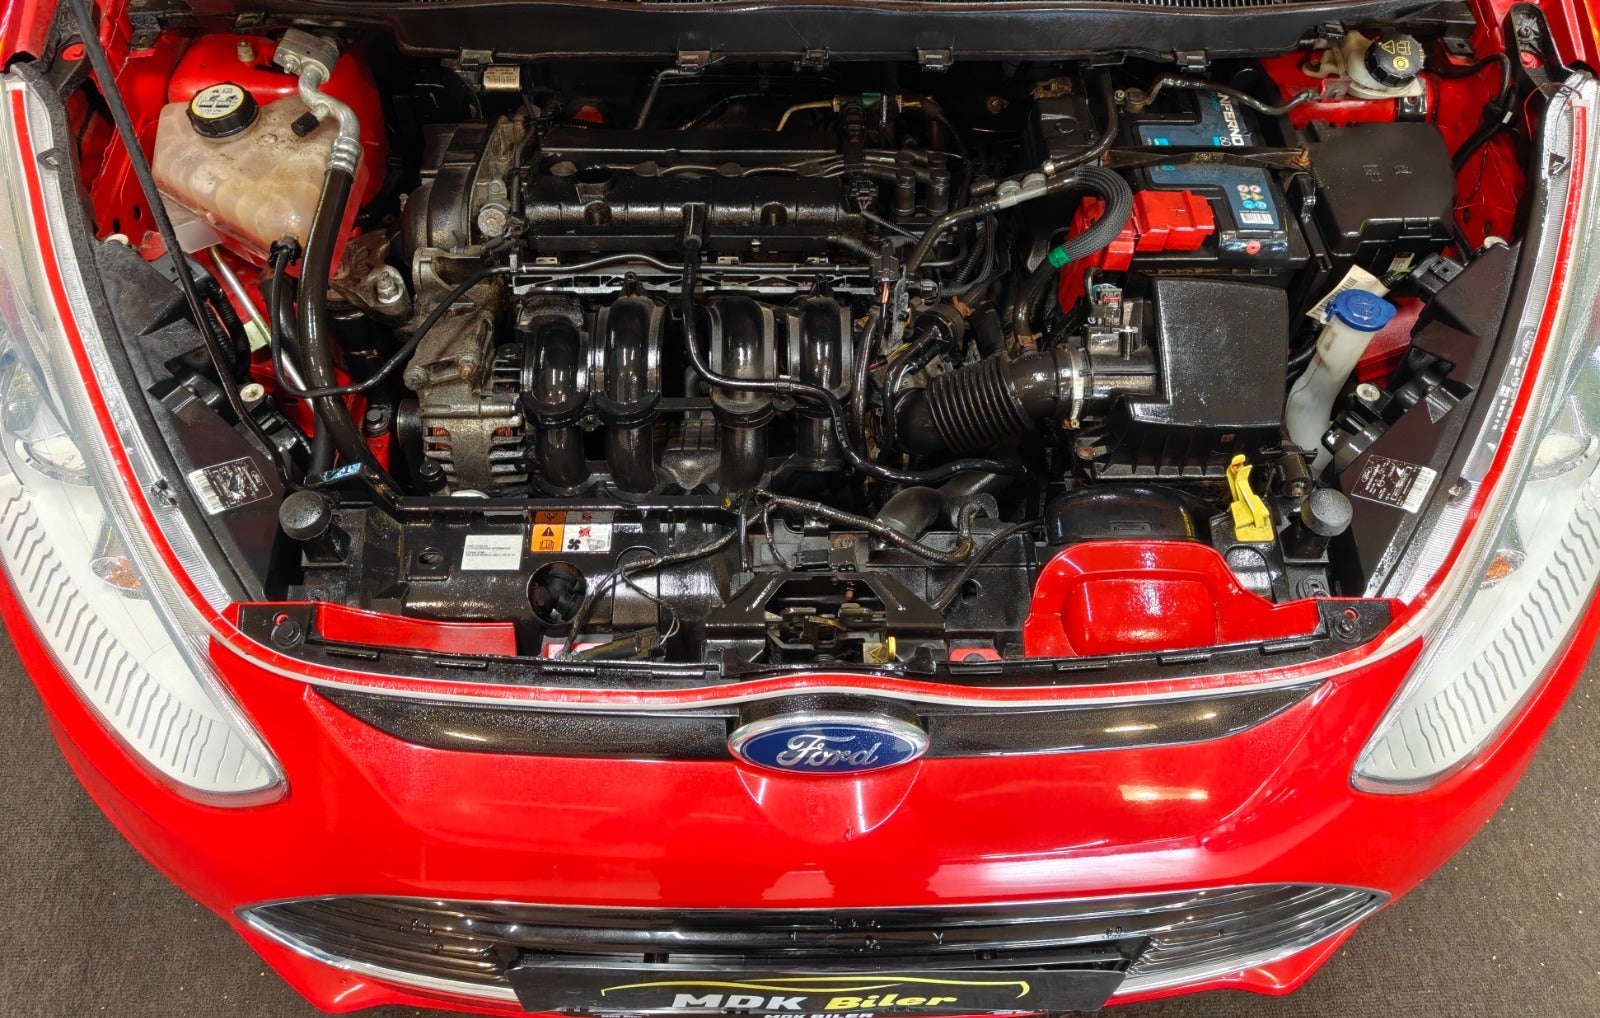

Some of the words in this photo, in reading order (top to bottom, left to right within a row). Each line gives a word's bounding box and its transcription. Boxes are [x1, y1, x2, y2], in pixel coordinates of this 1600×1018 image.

[775, 734, 882, 767] Ford
[671, 993, 809, 1010] MDK
[824, 993, 958, 1010] Biler
